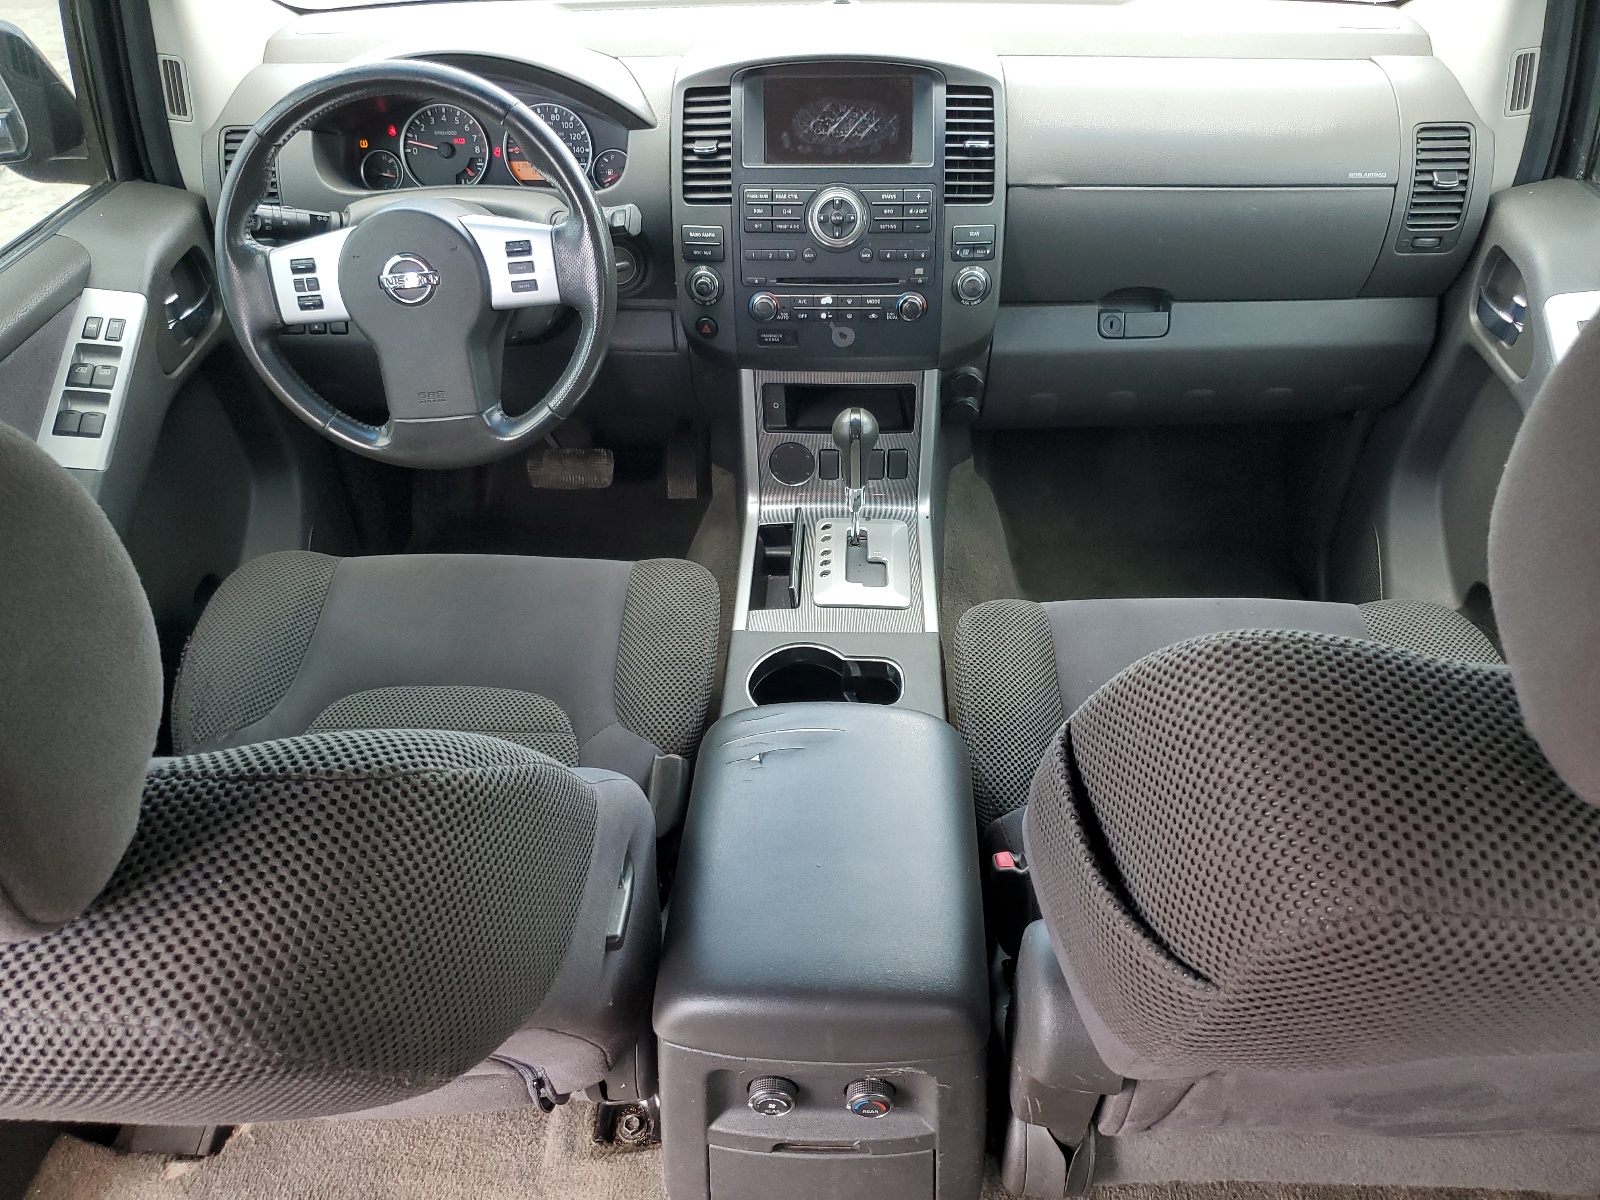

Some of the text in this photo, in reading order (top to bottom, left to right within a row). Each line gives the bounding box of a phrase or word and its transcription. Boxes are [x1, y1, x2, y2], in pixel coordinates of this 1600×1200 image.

[430, 117, 435, 125] 3
[441, 114, 447, 122] 4
[454, 117, 460, 125] 5
[420, 124, 426, 132] 2
[464, 124, 470, 132] 6
[472, 134, 477, 143] 7
[570, 133, 582, 141] 120
[412, 147, 418, 155] 0
[474, 145, 481, 154] 8
[572, 146, 585, 154] 140
[383, 273, 439, 288] NISAN
